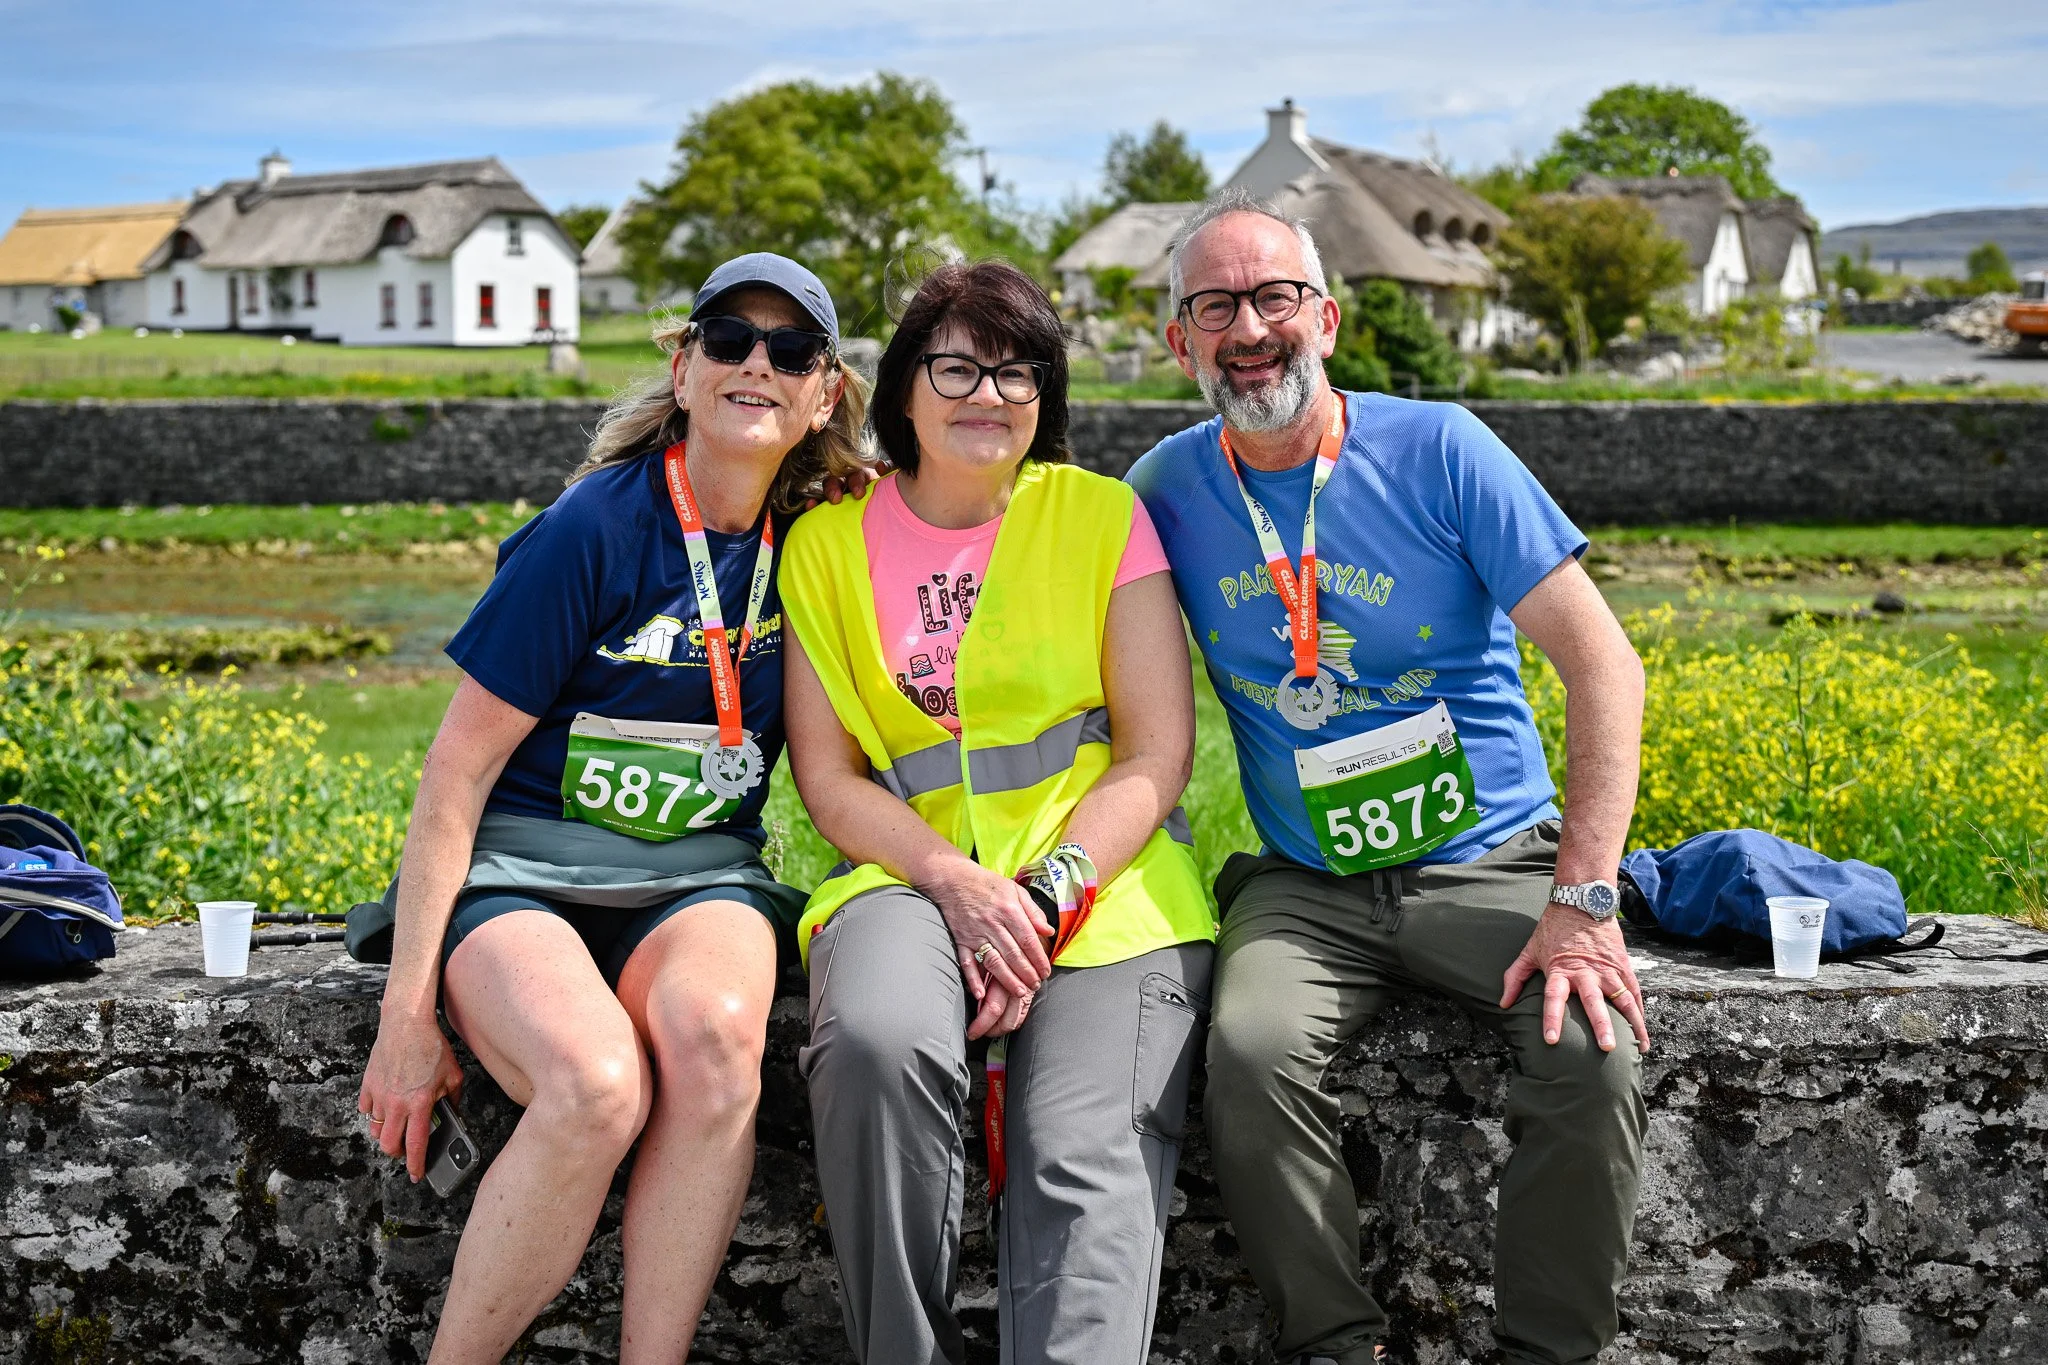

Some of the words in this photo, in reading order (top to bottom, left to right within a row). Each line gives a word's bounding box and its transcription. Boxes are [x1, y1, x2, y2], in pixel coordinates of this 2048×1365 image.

[669, 458, 683, 492] BURREN
[677, 493, 692, 522] CLARE
[694, 560, 711, 600] MONKS
[751, 568, 766, 604] MONKS
[1218, 563, 1279, 608] PAK
[1315, 559, 1394, 606] RYAN
[1280, 569, 1298, 601] CLARE
[1301, 565, 1309, 606] BURREN
[917, 572, 983, 634] Lif
[1300, 606, 1309, 640] CLARE
[710, 638, 724, 677] BURREN
[935, 646, 958, 665] lik
[718, 677, 730, 711] CLARE
[1336, 761, 1362, 775] RUN
[1361, 743, 1418, 768] RESULTS
[576, 757, 727, 829] 5872
[1326, 772, 1465, 857] 5873
